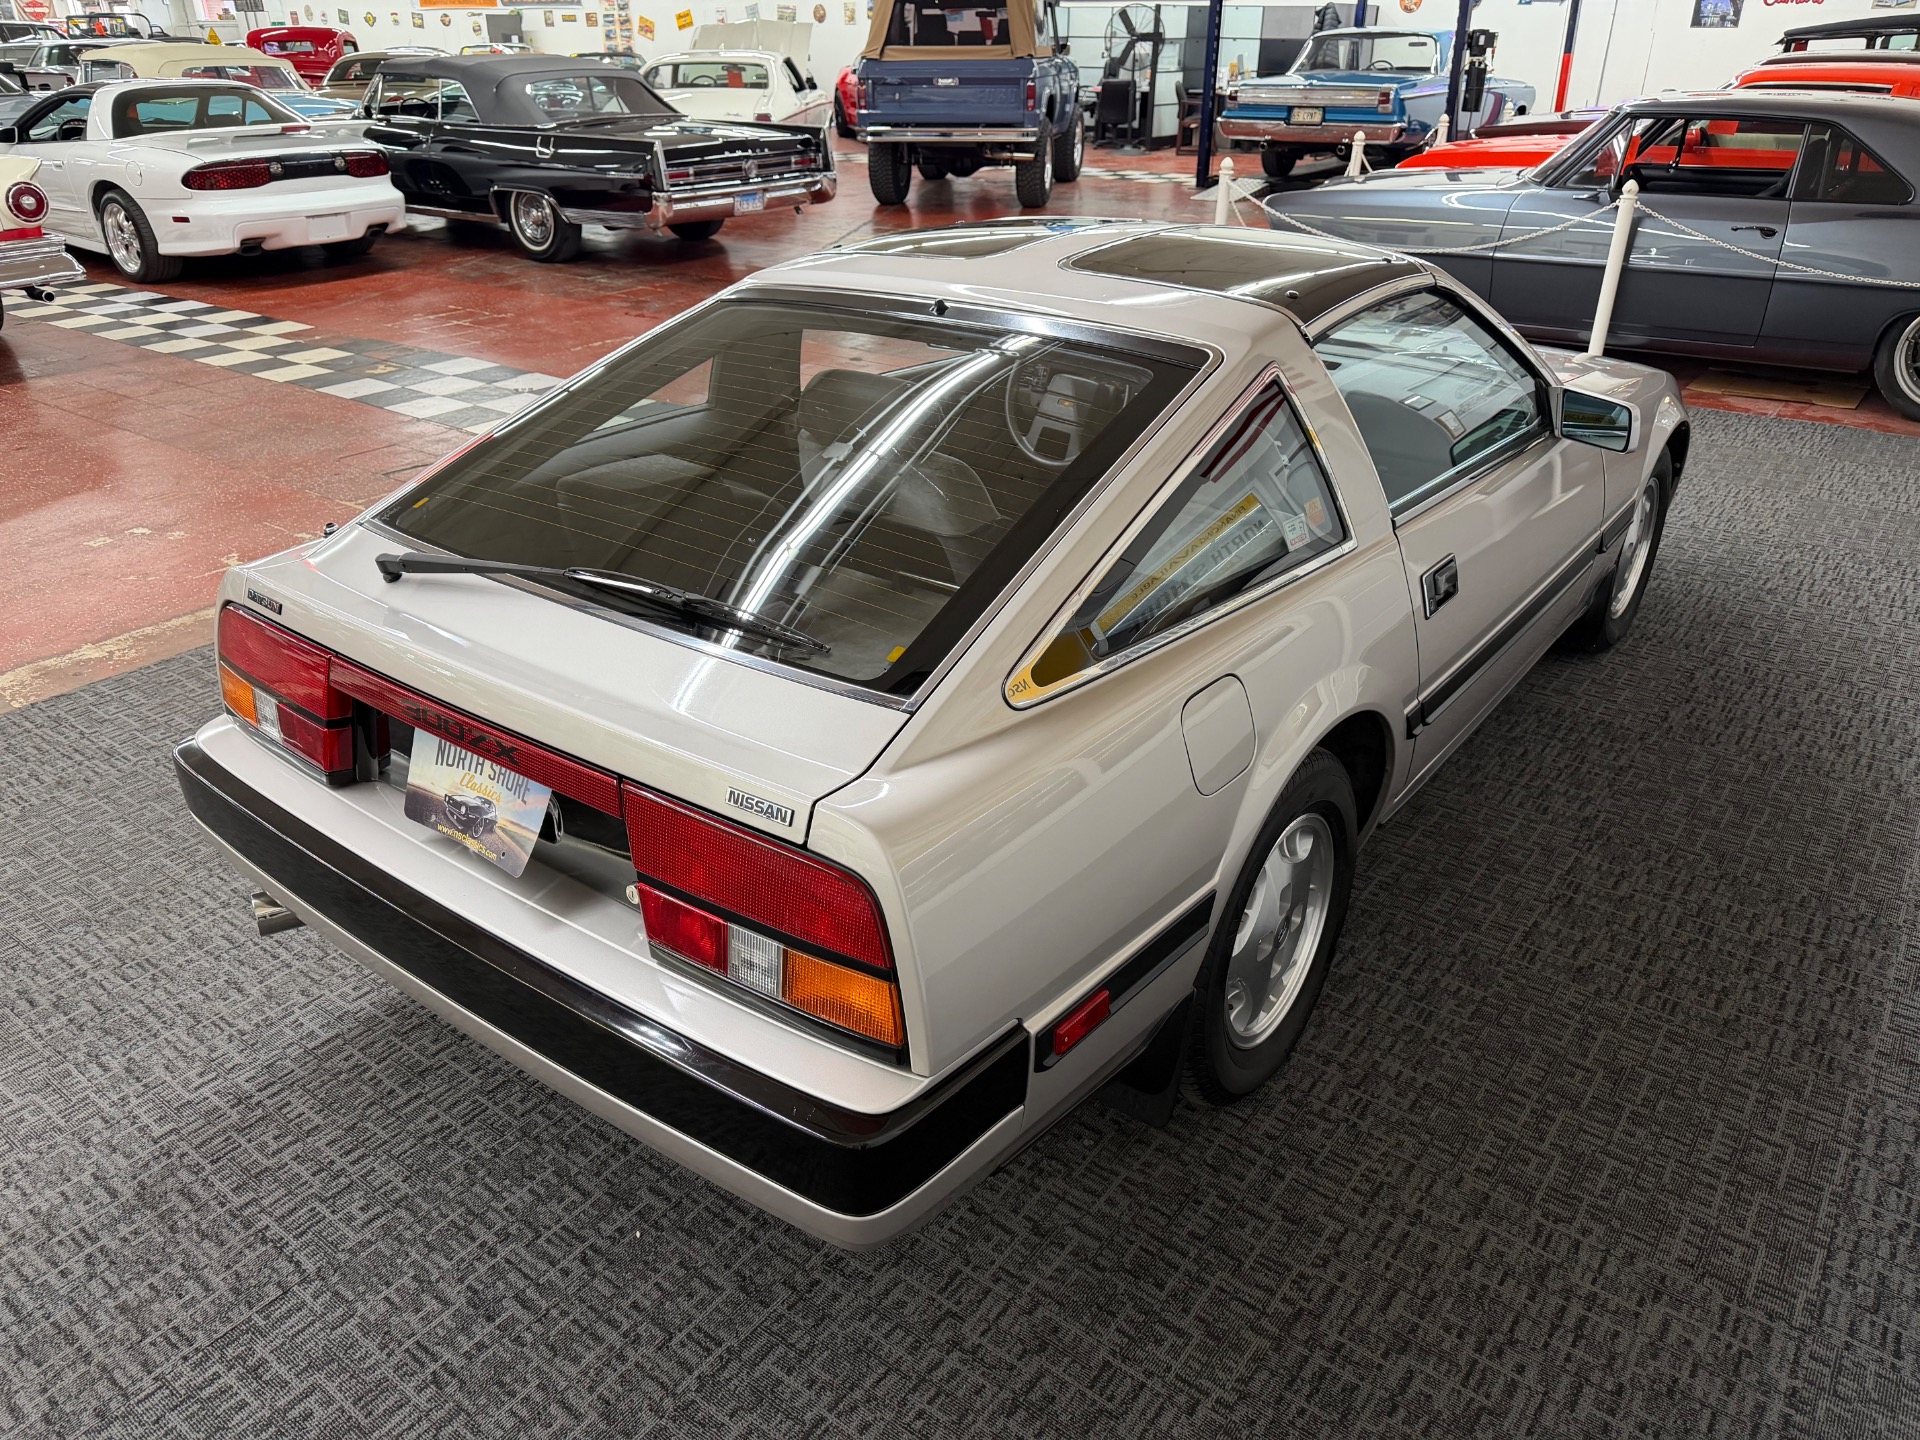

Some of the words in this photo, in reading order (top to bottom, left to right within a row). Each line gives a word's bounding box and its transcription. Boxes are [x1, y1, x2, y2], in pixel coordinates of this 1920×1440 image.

[400, 699, 521, 766] 300ZX
[435, 738, 486, 776] NORTH
[459, 771, 503, 803] Classics
[728, 790, 788, 823] NISSAN
[437, 824, 498, 861] www.nsclassics.com
